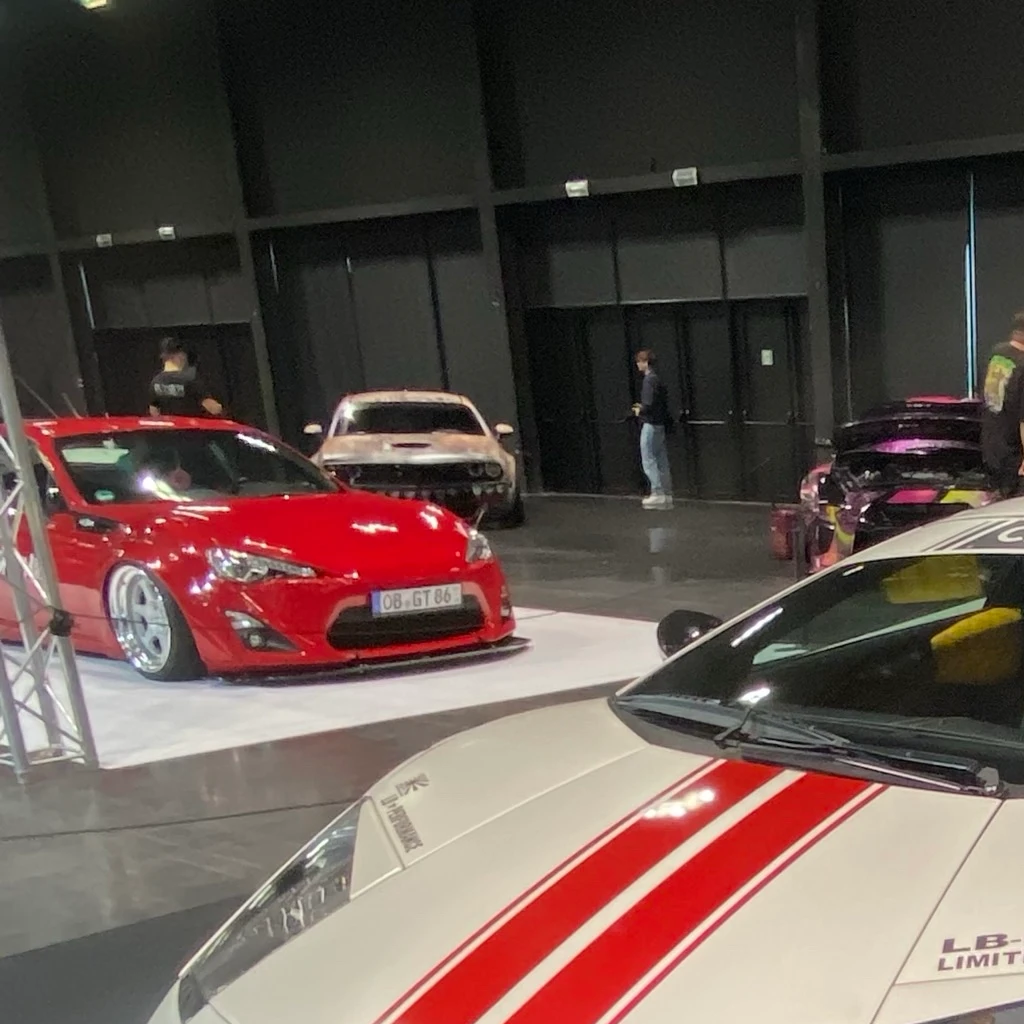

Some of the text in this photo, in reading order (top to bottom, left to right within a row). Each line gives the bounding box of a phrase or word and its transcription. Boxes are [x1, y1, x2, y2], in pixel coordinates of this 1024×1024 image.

[383, 588, 451, 610] OB GT 86
